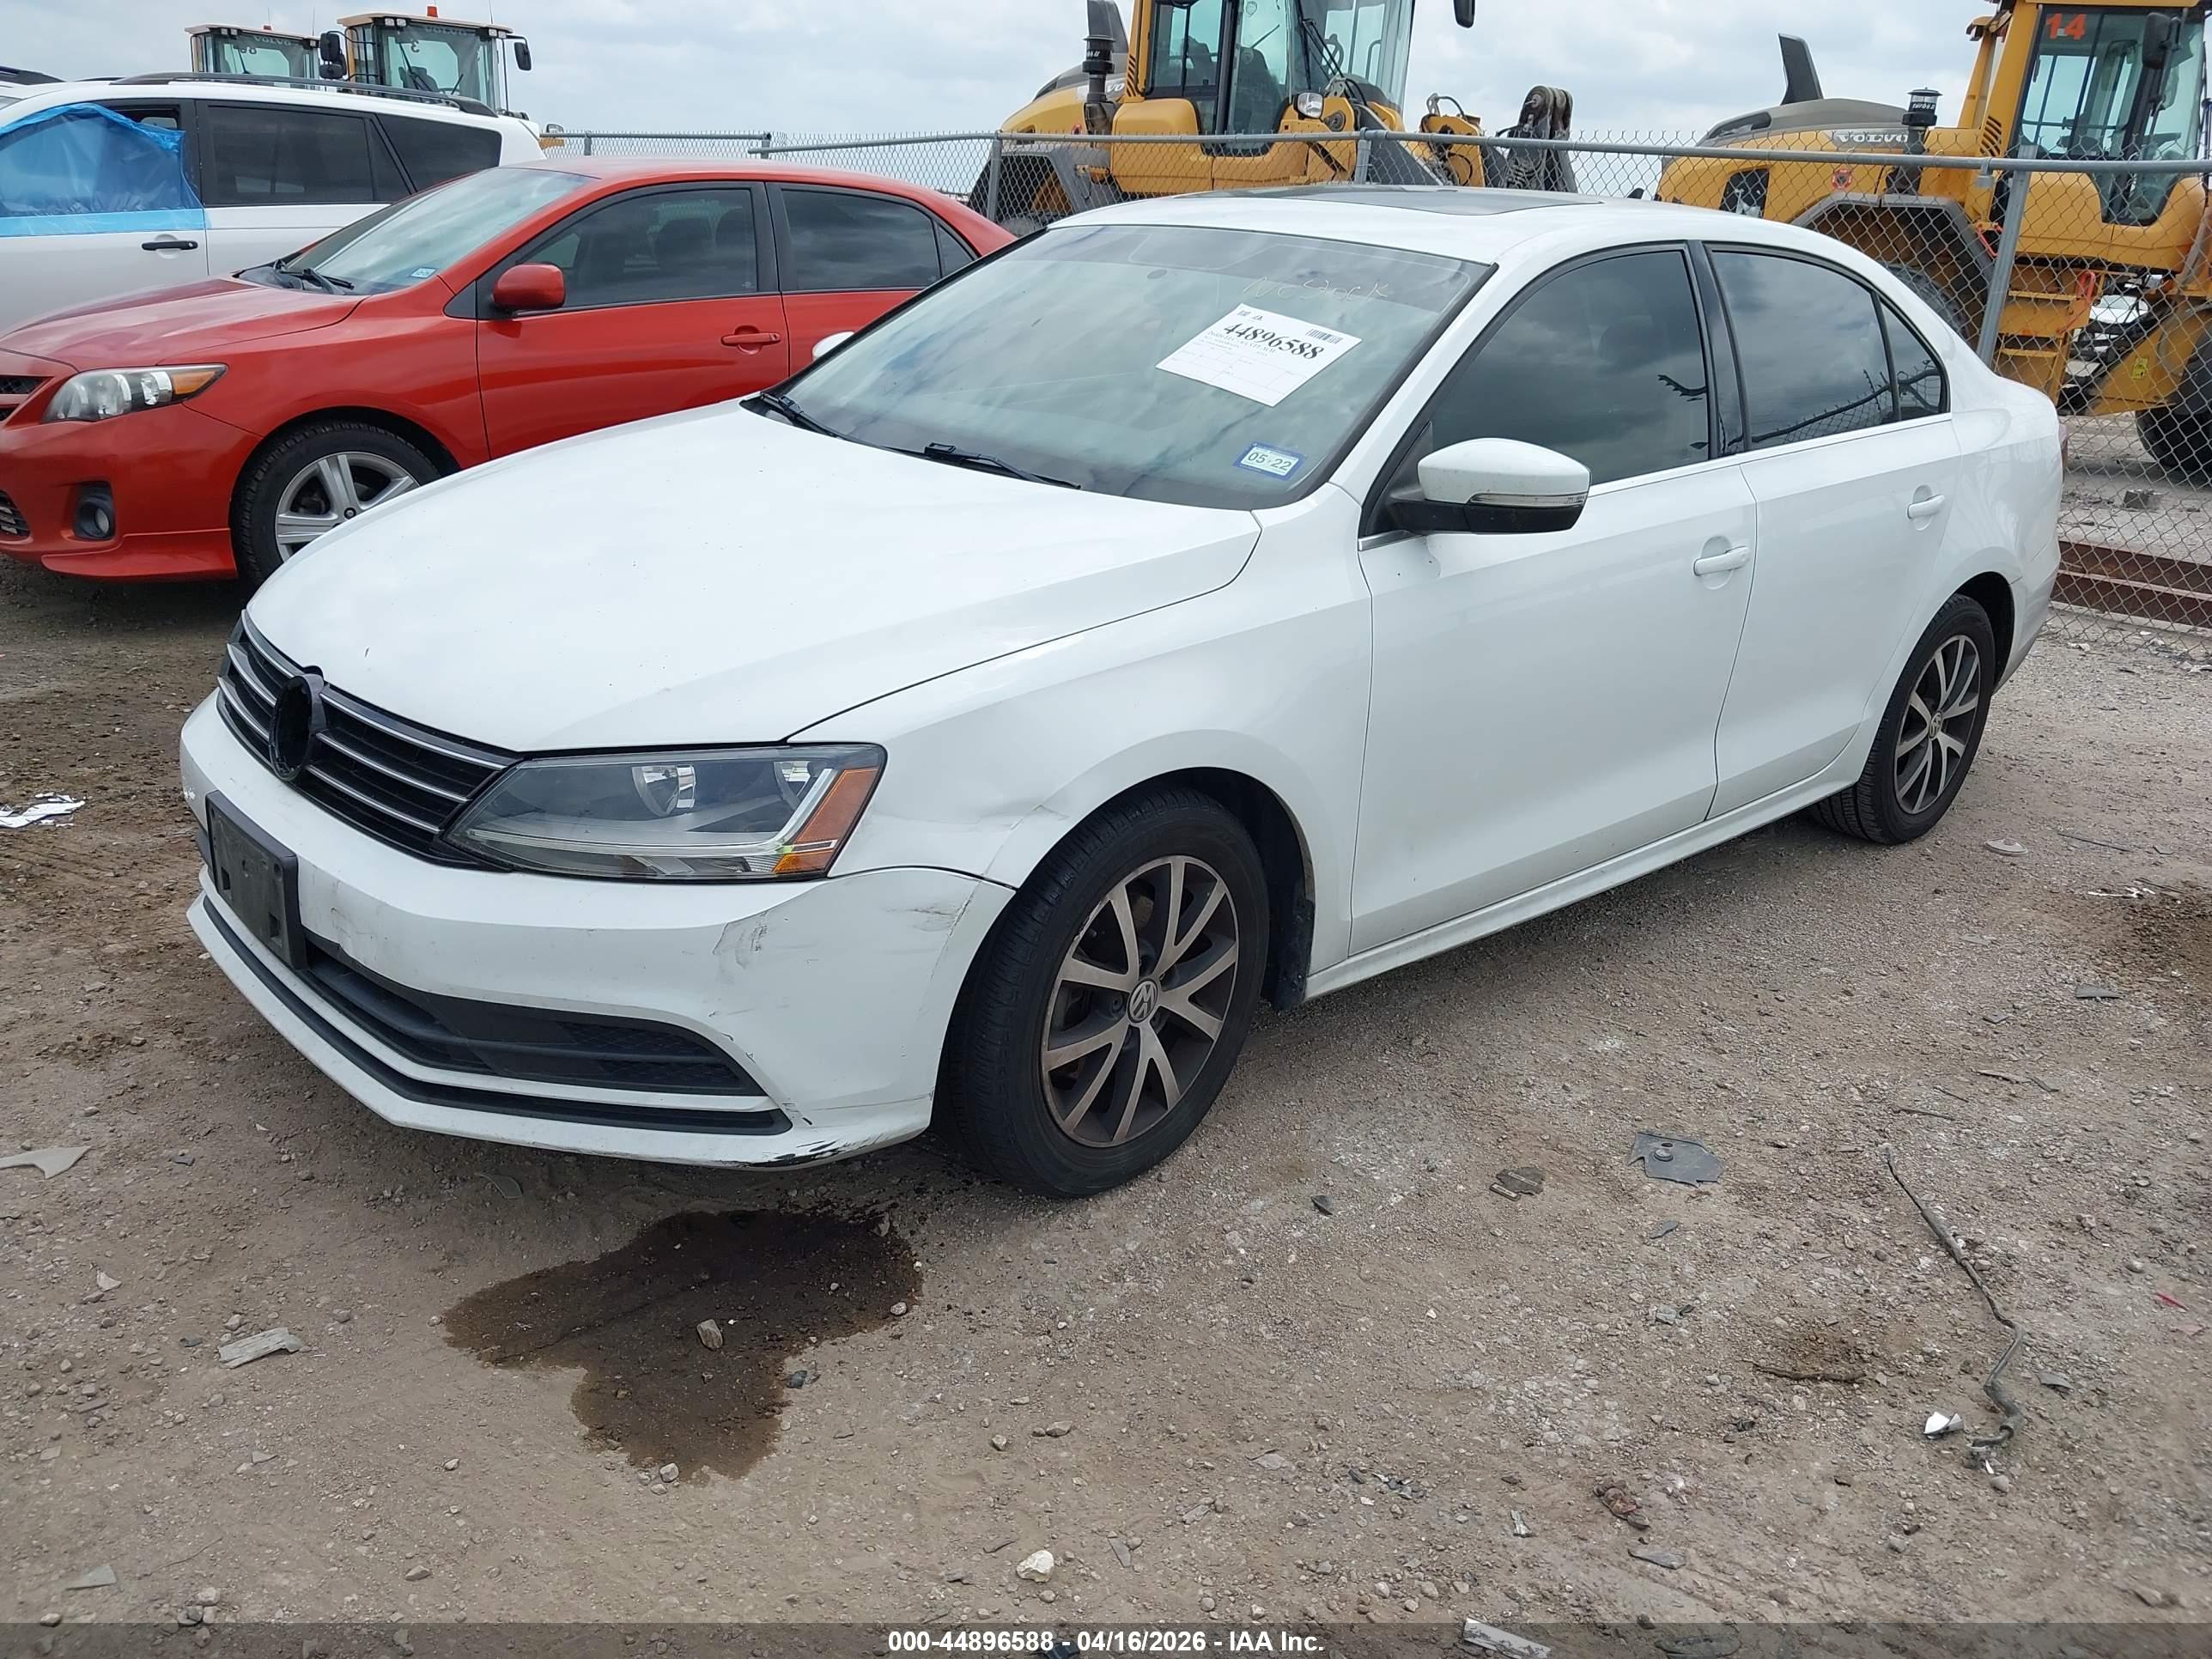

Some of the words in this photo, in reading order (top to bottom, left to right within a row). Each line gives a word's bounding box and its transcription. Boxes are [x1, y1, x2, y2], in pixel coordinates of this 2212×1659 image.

[2046, 13, 2086, 40] 14
[253, 35, 291, 46] VOLVO
[1836, 134, 1908, 143] VOLVO
[1224, 324, 1324, 359] 44896588
